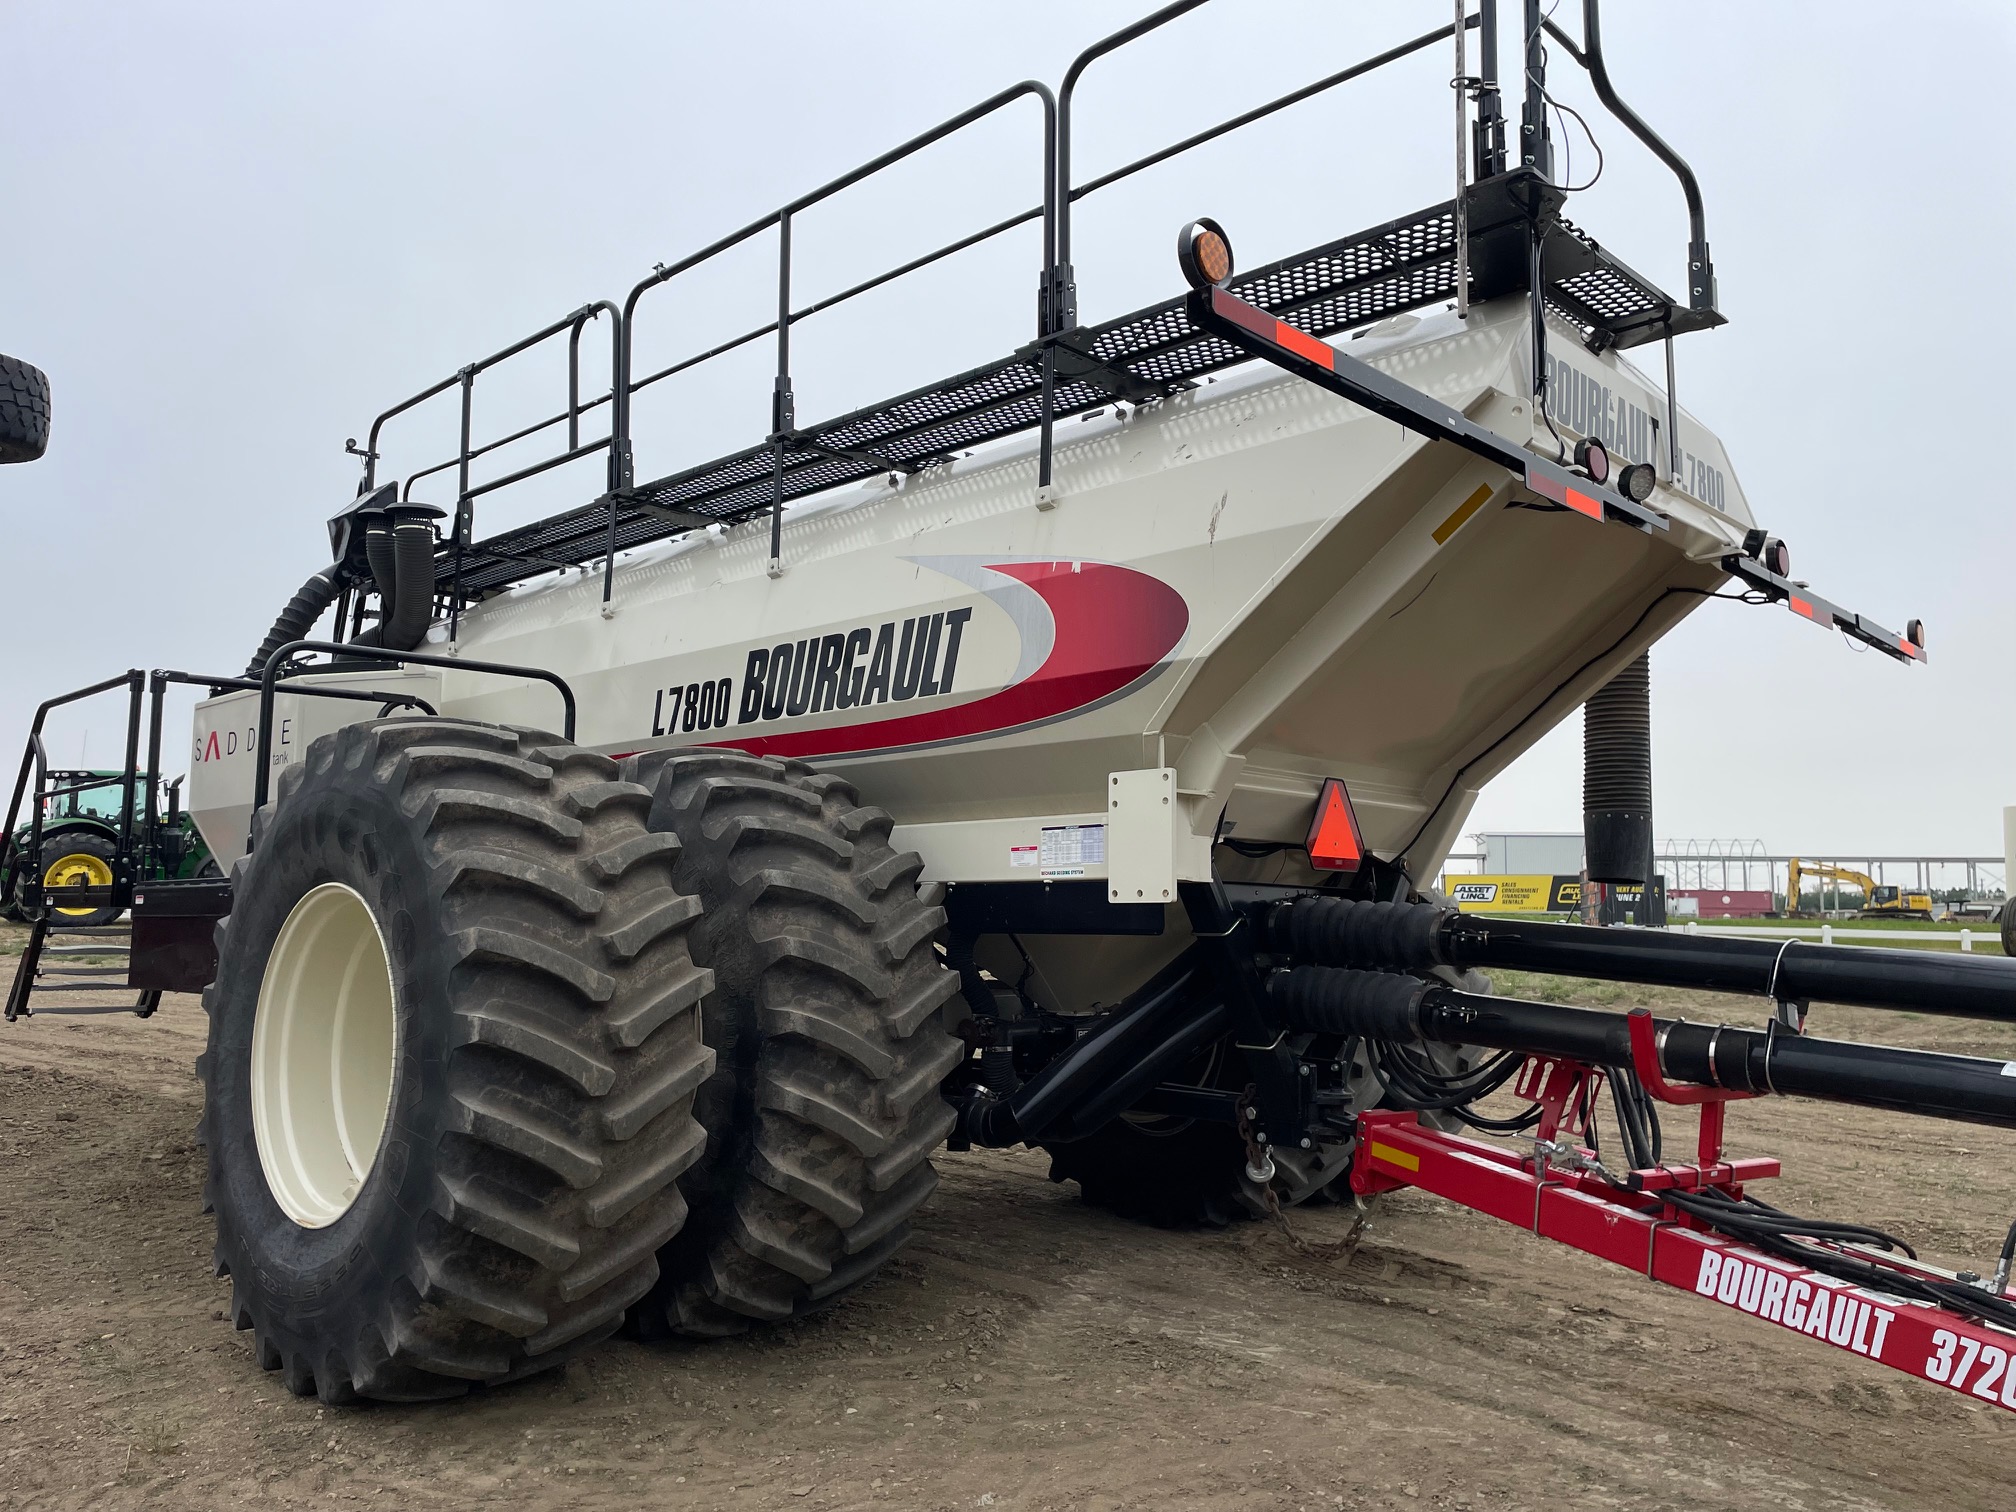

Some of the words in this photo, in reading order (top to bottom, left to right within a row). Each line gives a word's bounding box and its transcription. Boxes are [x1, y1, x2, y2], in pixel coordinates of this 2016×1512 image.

[652, 678, 732, 737] L7800
[738, 606, 973, 725] BOURGAULT
[194, 718, 292, 762] SADDE
[272, 751, 289, 766] tank
[1696, 1248, 1896, 1360] BOURGAULT
